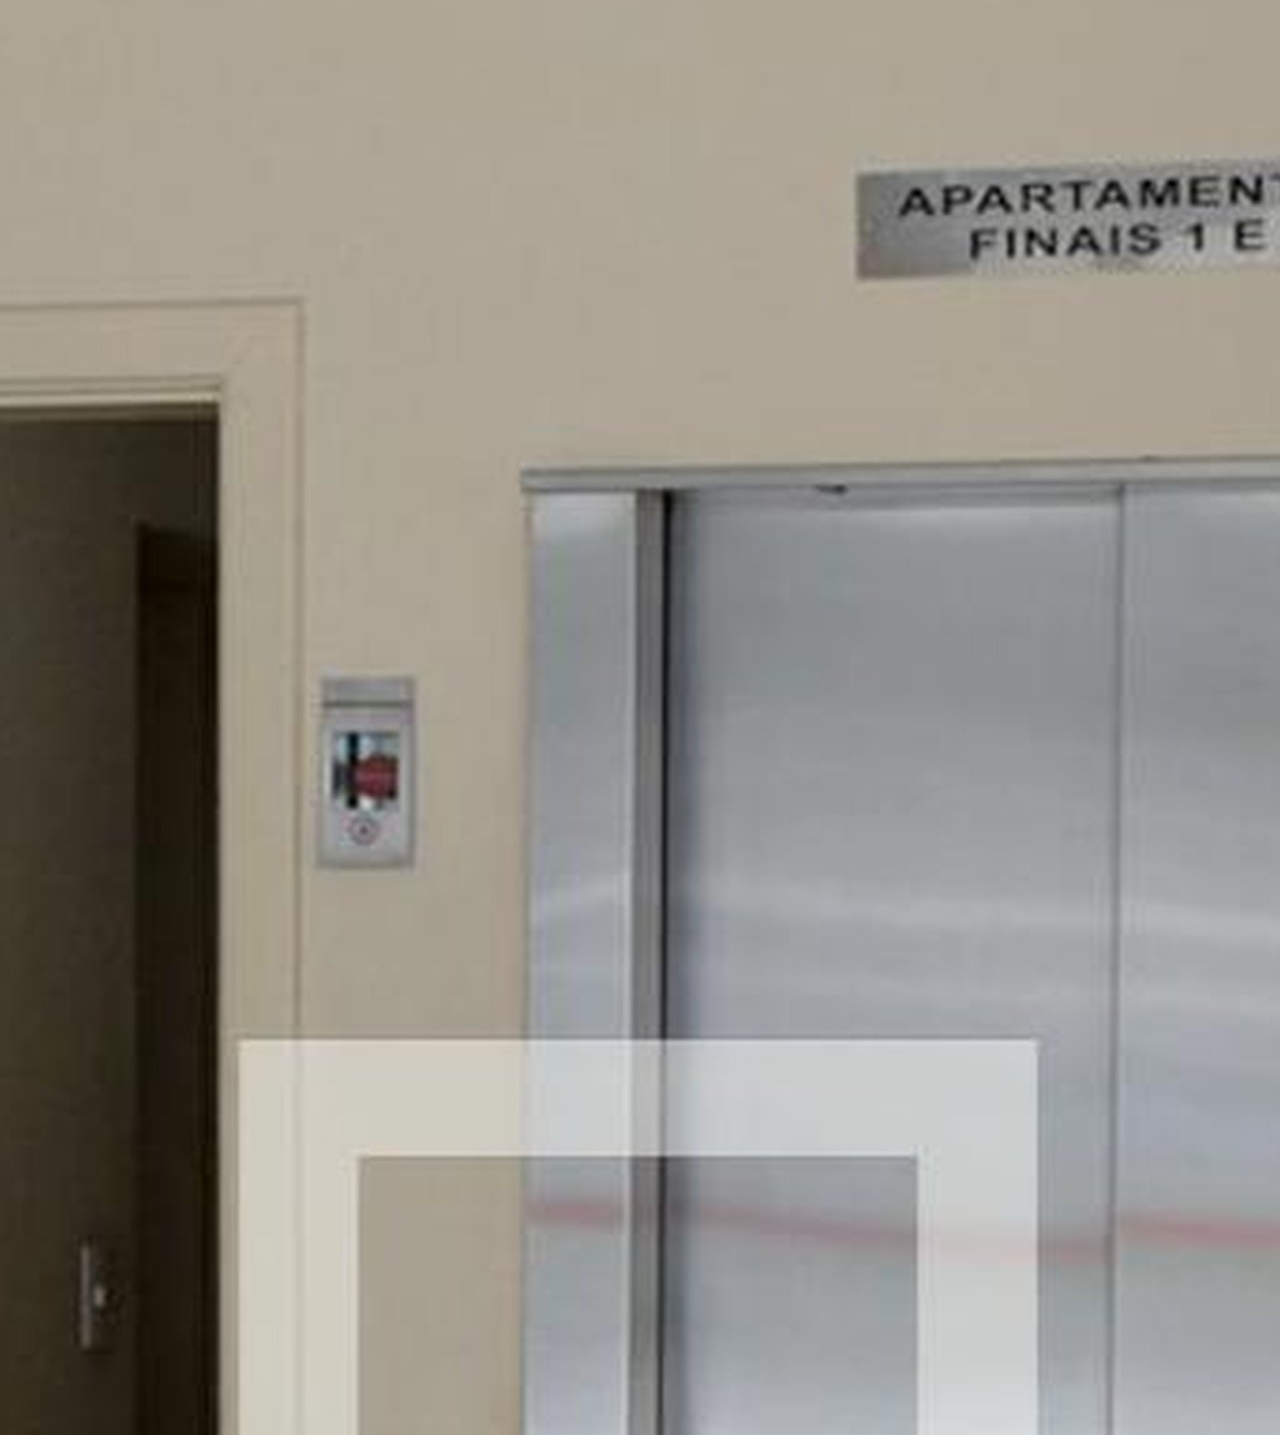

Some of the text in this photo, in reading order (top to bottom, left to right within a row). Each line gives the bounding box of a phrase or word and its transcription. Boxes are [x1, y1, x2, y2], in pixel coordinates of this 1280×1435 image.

[969, 223, 1162, 260] FINAIS
[1184, 223, 1206, 251] 1
[1234, 219, 1265, 251] E
